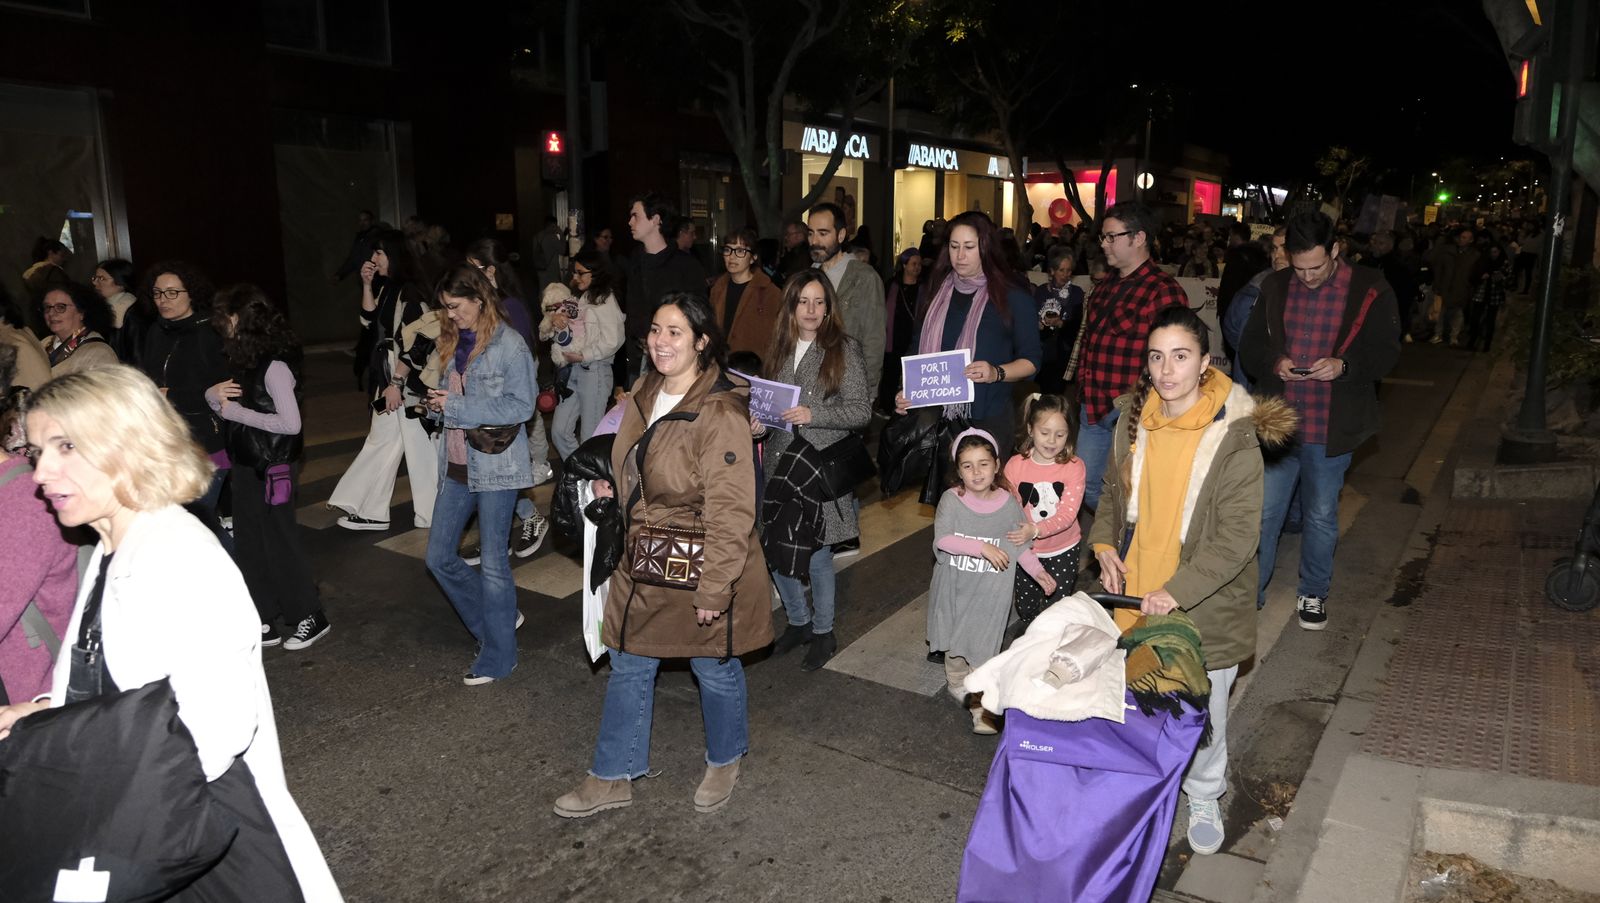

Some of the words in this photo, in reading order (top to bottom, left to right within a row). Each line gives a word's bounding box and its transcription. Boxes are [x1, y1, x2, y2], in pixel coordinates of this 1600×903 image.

[803, 127, 869, 158] ABACA
[910, 144, 958, 170] ABANCA
[921, 363, 939, 374] POR
[940, 361, 948, 372] TI
[921, 375, 939, 387] POR
[749, 386, 762, 398] OR
[764, 389, 774, 400] TI
[911, 389, 929, 400] POR
[930, 386, 962, 398] TODAS
